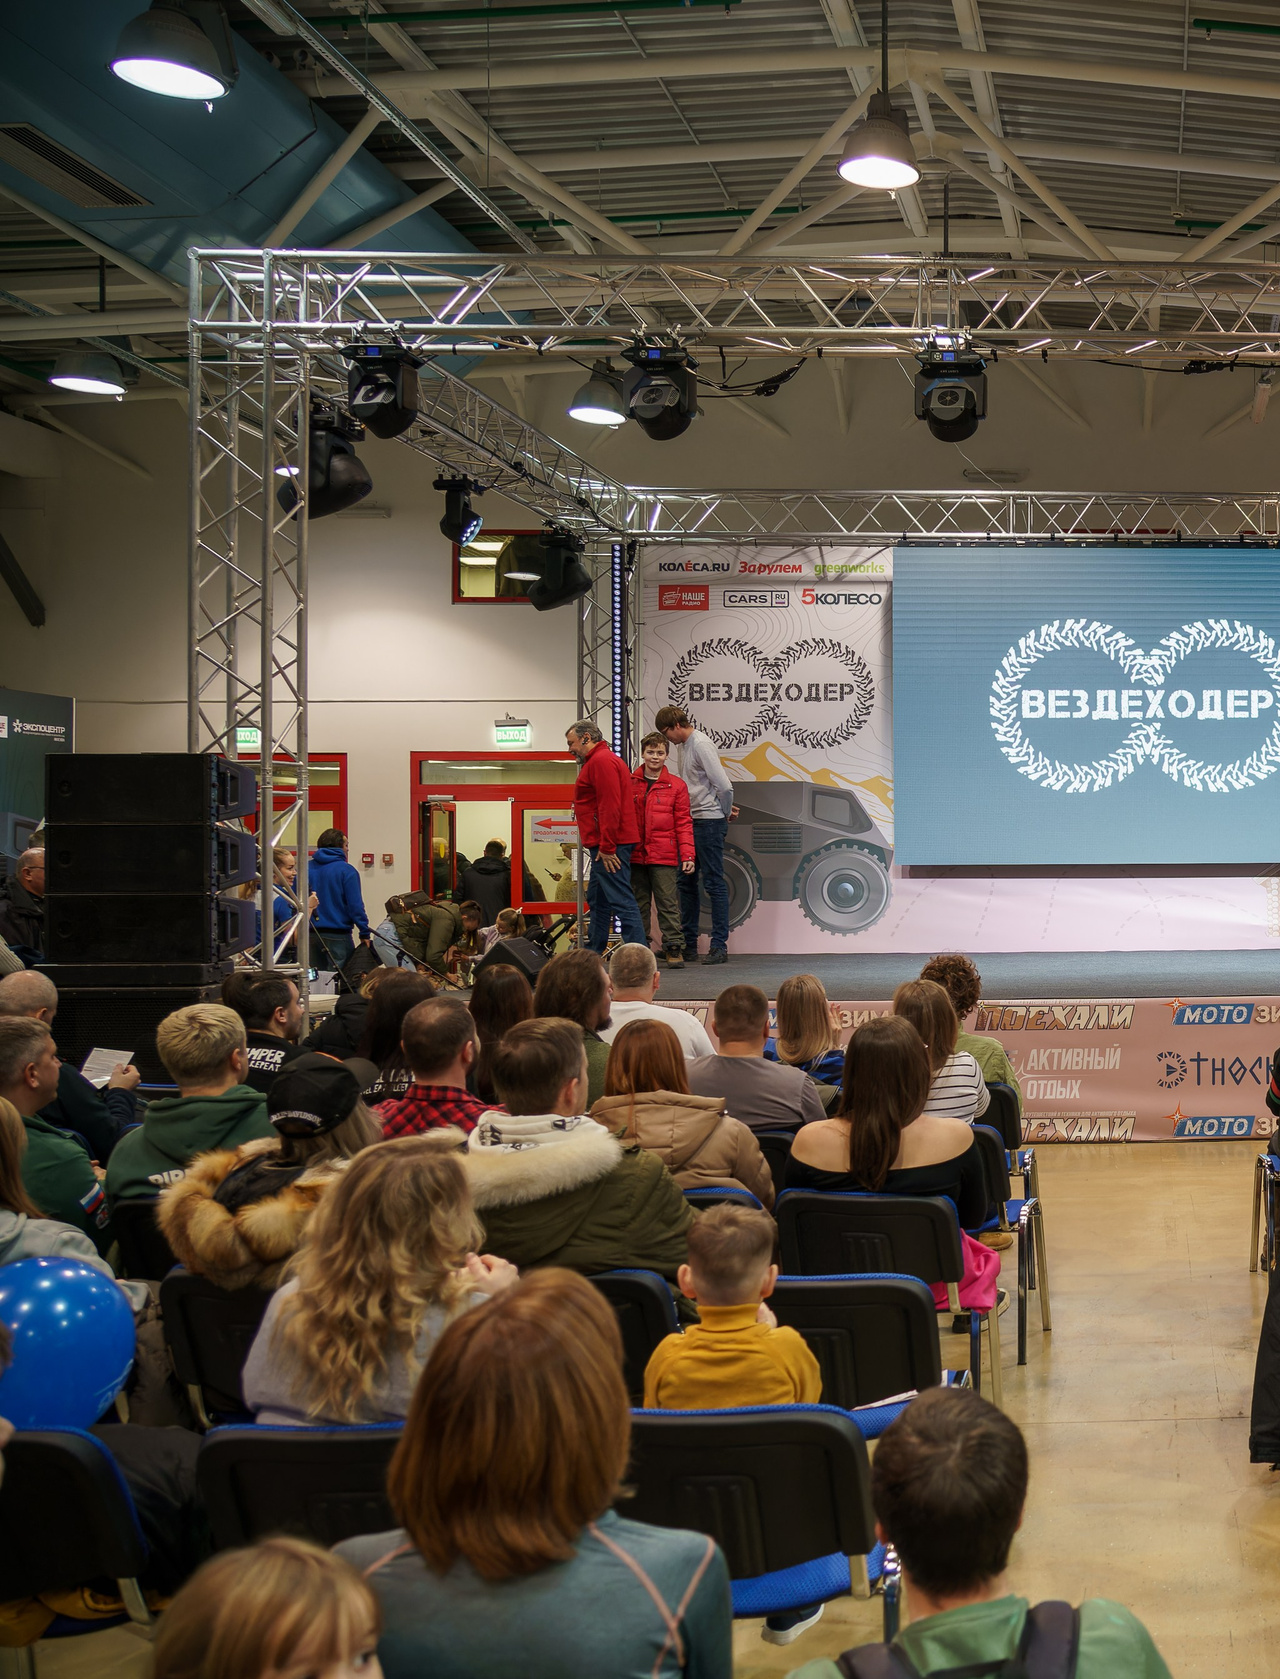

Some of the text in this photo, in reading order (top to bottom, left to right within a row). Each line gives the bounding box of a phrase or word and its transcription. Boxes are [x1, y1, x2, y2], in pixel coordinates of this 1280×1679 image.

[814, 562, 885, 576] greenworks
[682, 592, 705, 600] НАШЕ
[728, 595, 768, 604] CARS
[689, 682, 854, 702] ВЕЗДЕХОДЕР
[1021, 689, 1274, 720] ВЕЗДЕХОДЕР
[22, 723, 66, 734] ЭКСПОЦЕНТР
[497, 730, 527, 741] ВЫХОД
[975, 1005, 1135, 1031] ПОЕХАЛИ
[1182, 1005, 1248, 1024] МОТО
[1026, 1043, 1121, 1070] АКТИВНЫЙ
[1026, 1080, 1081, 1099] ОТДЫХ
[1020, 1118, 1136, 1141] ЕХАЛИ
[1184, 1117, 1249, 1135] МОТО
